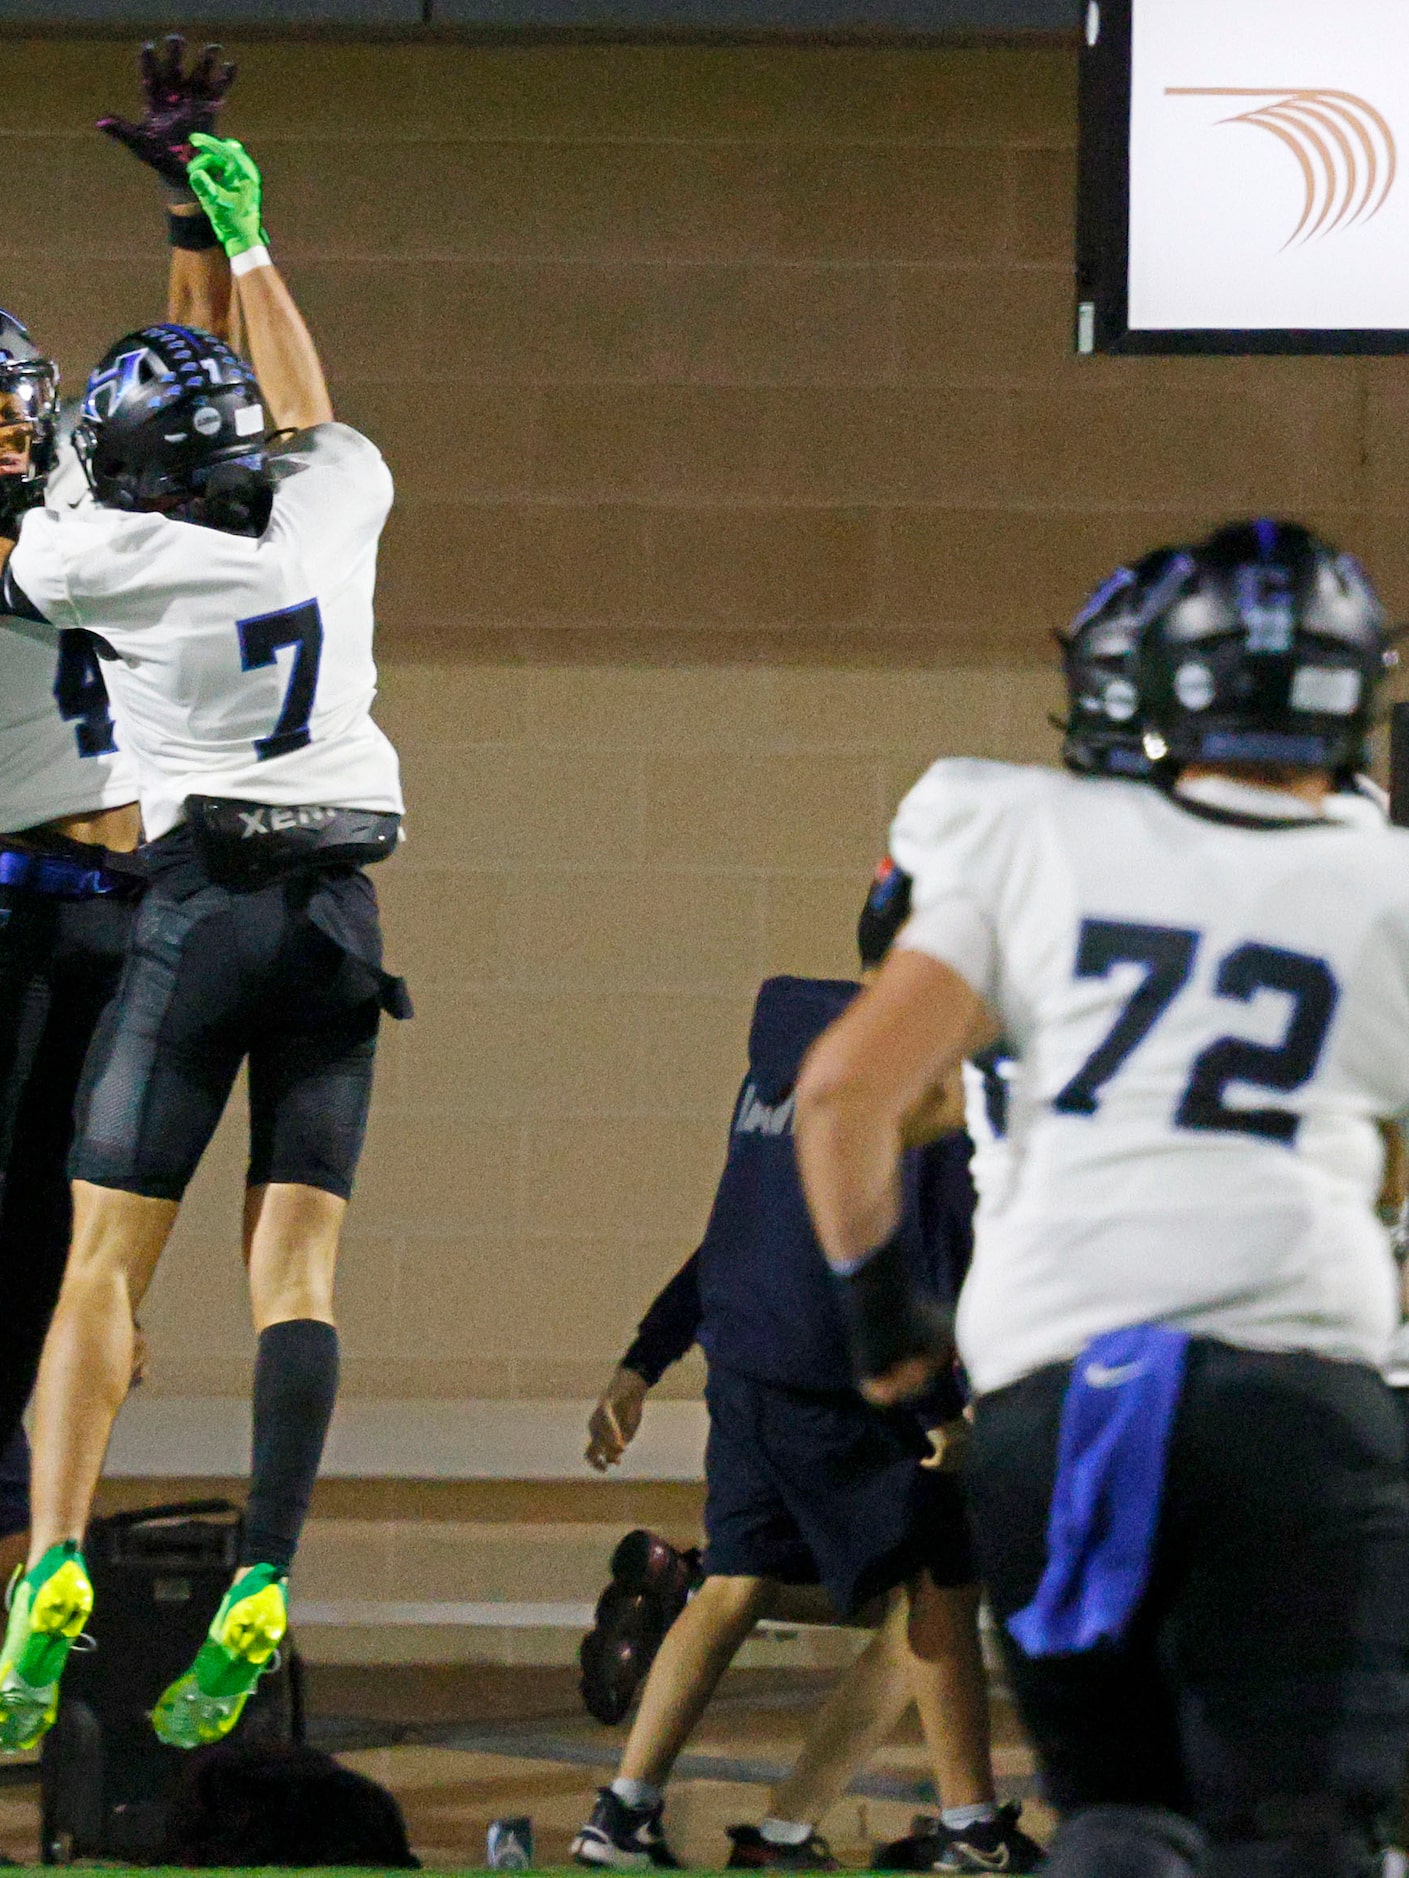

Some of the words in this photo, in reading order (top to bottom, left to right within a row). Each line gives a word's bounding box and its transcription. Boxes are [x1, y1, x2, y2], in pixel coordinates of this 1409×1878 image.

[54, 629, 119, 758] 4
[237, 598, 324, 761] 7
[1053, 916, 1340, 1144] 72
